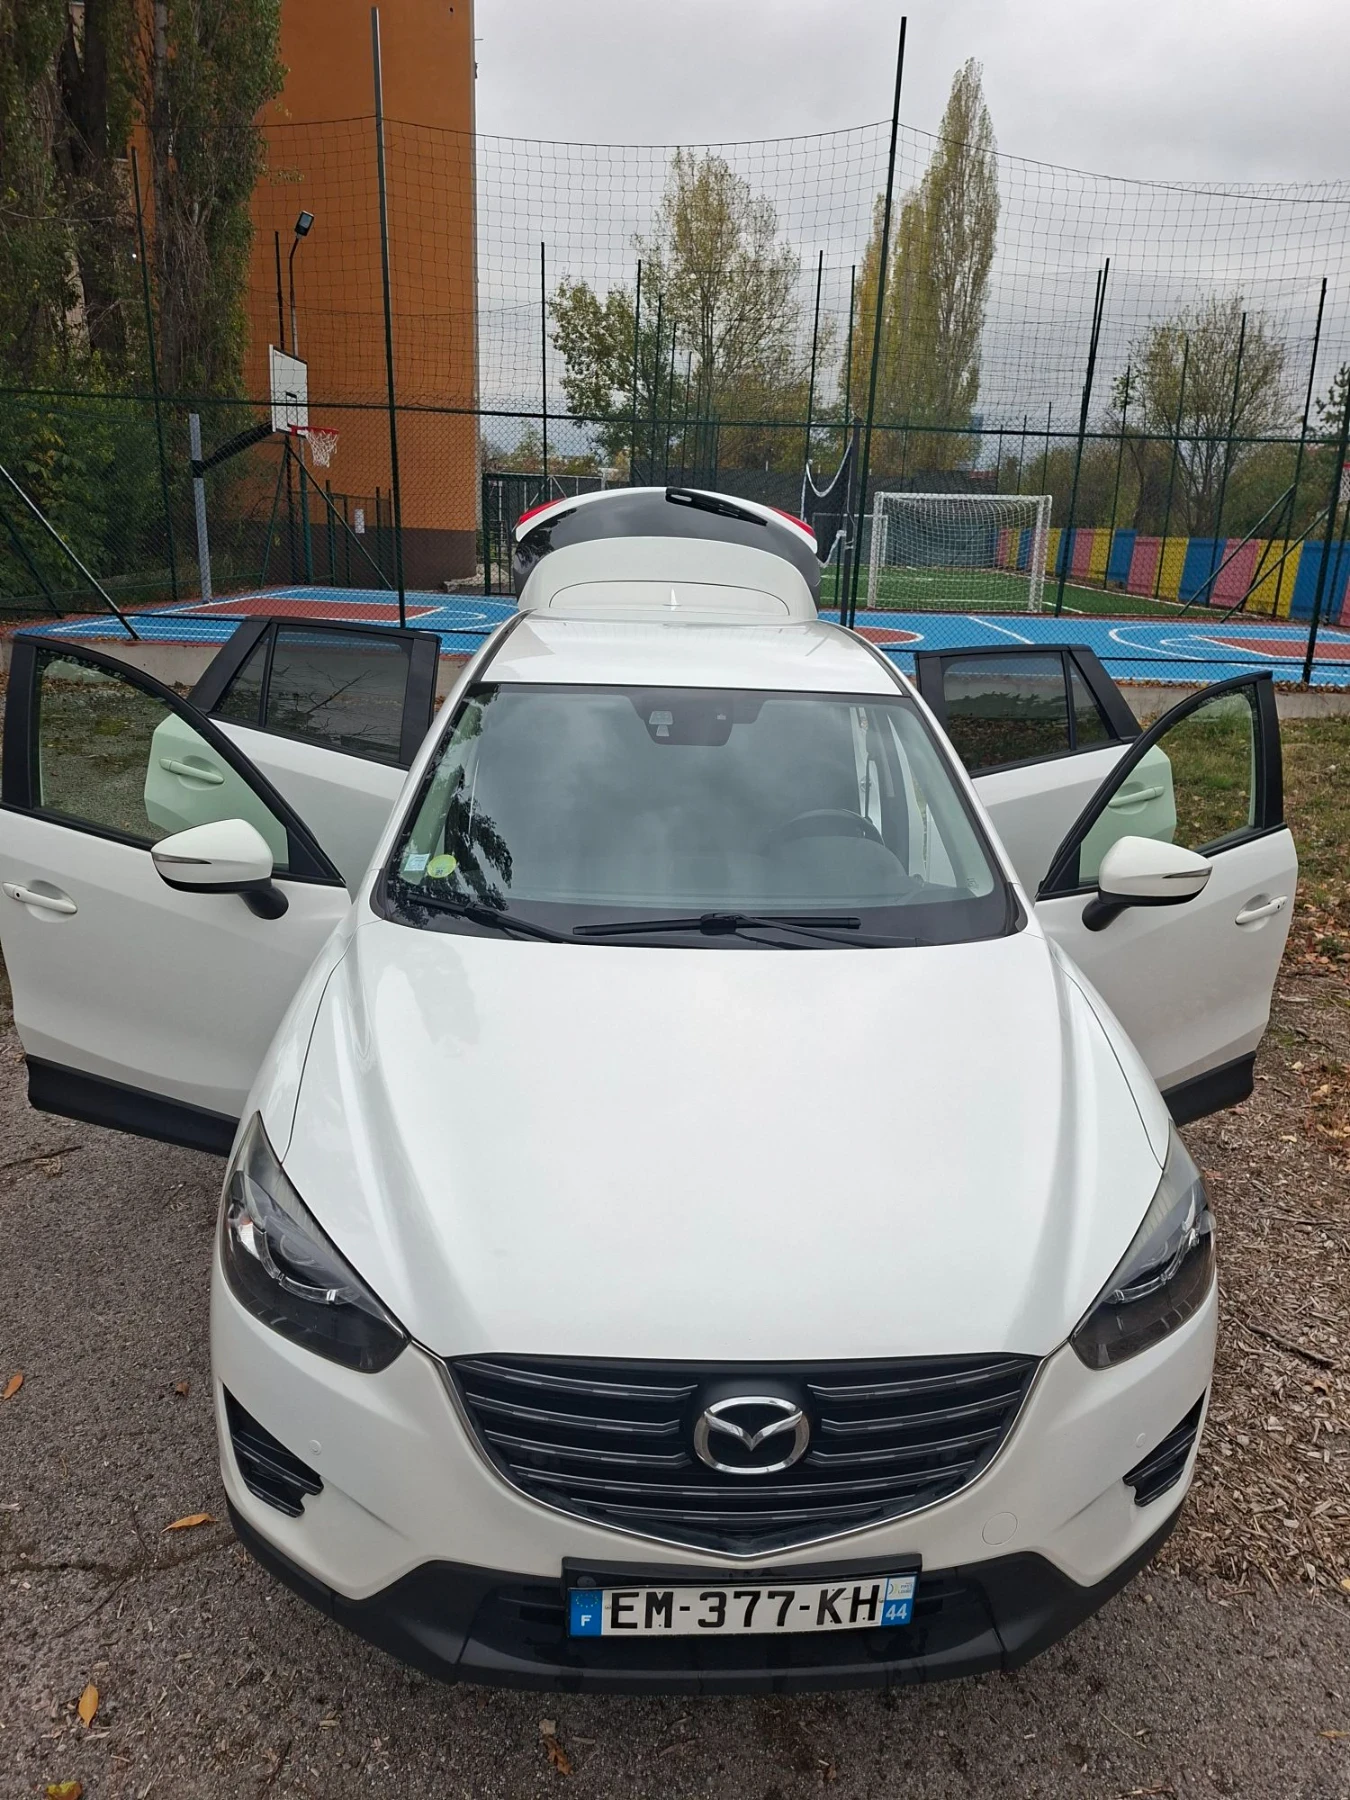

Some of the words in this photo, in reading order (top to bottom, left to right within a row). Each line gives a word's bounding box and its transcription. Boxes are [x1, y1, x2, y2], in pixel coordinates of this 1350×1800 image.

[611, 1585, 880, 1629] EM-377-KH
[885, 1603, 907, 1621] 44
[580, 1614, 592, 1627] F
